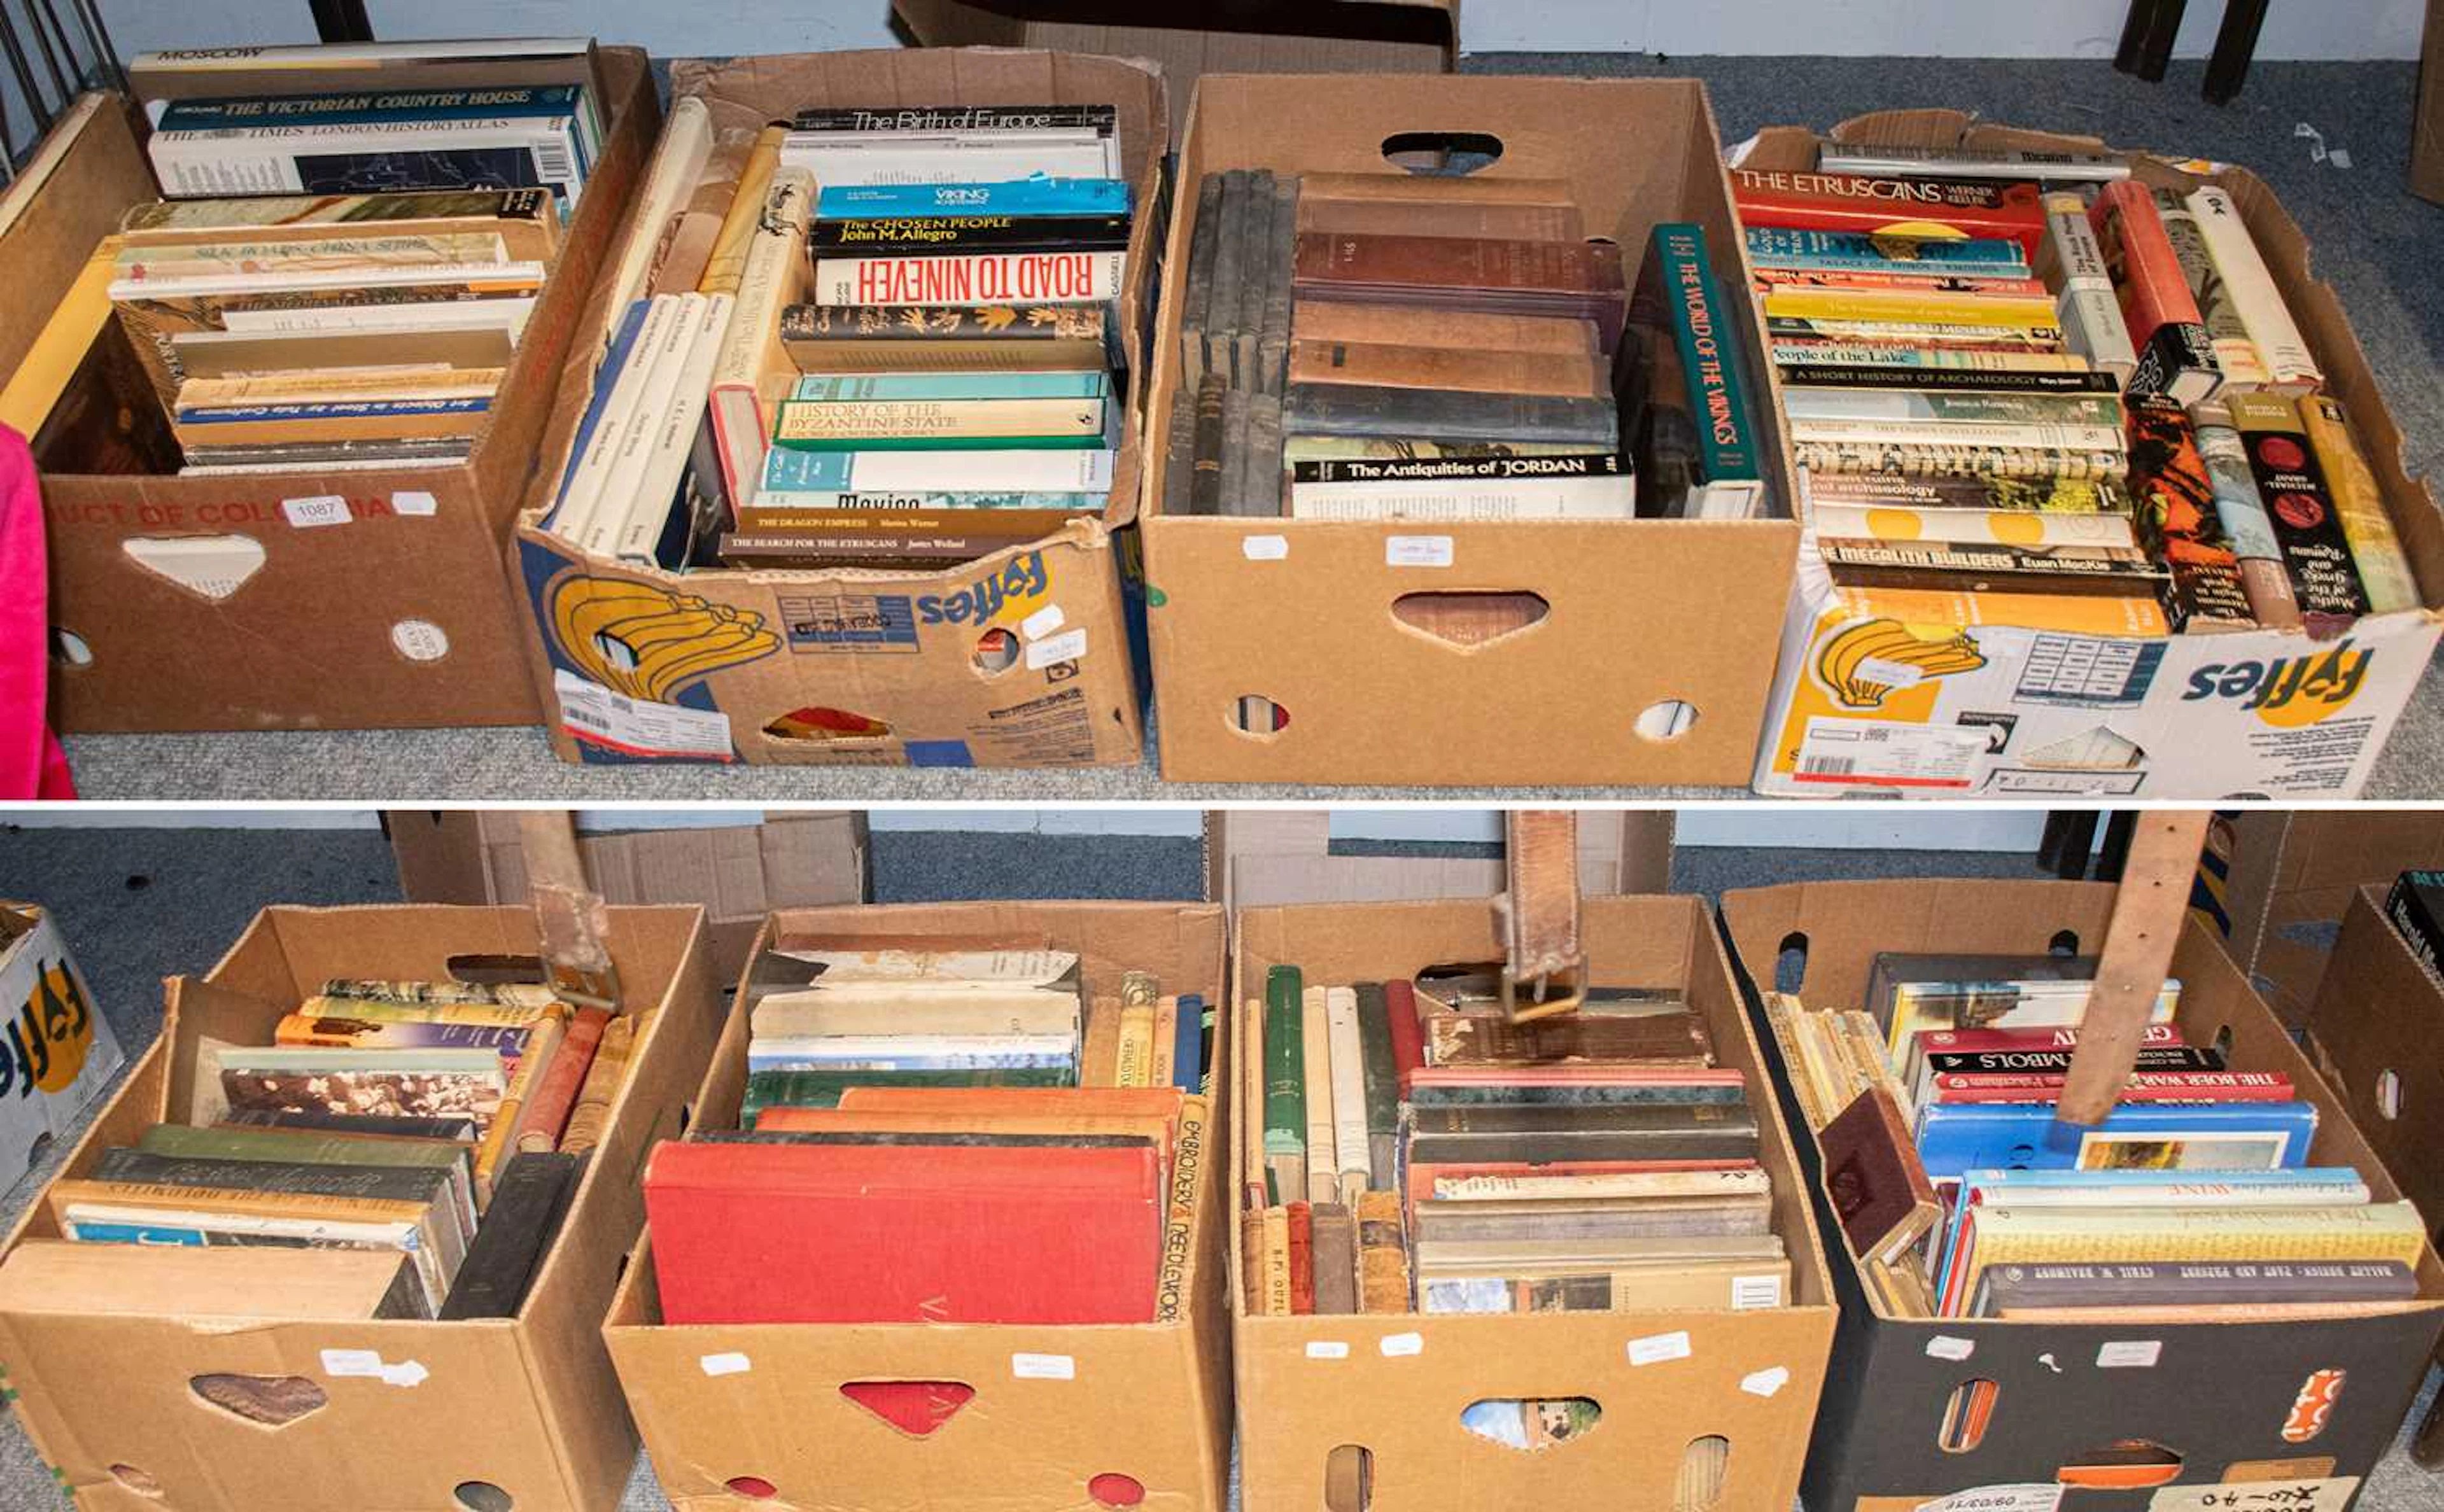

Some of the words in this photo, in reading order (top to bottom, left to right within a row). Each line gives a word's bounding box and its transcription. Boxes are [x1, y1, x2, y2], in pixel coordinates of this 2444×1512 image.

[158, 48, 264, 61] MOSCOW
[225, 103, 263, 116] THE
[267, 97, 370, 115] VICTORIAN
[376, 94, 466, 109] COUNTRY
[468, 90, 532, 106] HOUSE
[853, 111, 893, 130] The
[897, 108, 946, 130] Birth
[949, 106, 971, 129] of
[974, 109, 1051, 128] Europe
[162, 130, 197, 142] THE
[248, 128, 304, 139] TIMES
[1734, 169, 1788, 190] THE
[1792, 174, 1942, 203] ETRUSCANS
[935, 188, 990, 201] VIKING
[841, 220, 870, 230] The
[872, 219, 948, 230] CHOSEN
[950, 217, 1013, 228] PEOPLE
[839, 228, 876, 242] John
[878, 230, 899, 241] M.
[899, 228, 958, 242] Allegro
[977, 256, 1016, 300] TO
[1017, 255, 1094, 298] ROAD
[1678, 262, 1701, 285] THE
[858, 258, 973, 305] NINEVEH
[1683, 284, 1713, 337] WORLD
[1694, 336, 1719, 362] OF
[1822, 349, 1837, 361] of
[1840, 349, 1866, 361] the
[1869, 351, 1909, 363] Lake
[1699, 360, 1724, 384] THE
[1812, 370, 1855, 380] SHORT
[1858, 371, 1914, 381] HISTORY
[791, 404, 870, 417] HISTORY
[904, 404, 943, 417] THE
[1706, 385, 1739, 445] VIKINGS
[789, 417, 899, 430] BYZANTINE
[901, 416, 958, 429] STATE
[1347, 463, 1382, 478] The
[1384, 462, 1475, 479] Antiquities
[1477, 461, 1498, 475] of
[1501, 458, 1587, 476] JORDAN
[1839, 484, 1936, 498] archaeology
[139, 503, 185, 524] OF
[297, 503, 335, 517] 1087
[731, 538, 753, 548] THE
[795, 538, 815, 548] FOR
[817, 538, 838, 549] THE
[1839, 548, 1929, 563] MEGALITH
[1930, 550, 2015, 569] BUILDERS
[2021, 557, 2058, 568] Euan
[2307, 559, 2333, 570] and
[2151, 1072, 2187, 1086] WAR
[2189, 1073, 2239, 1086] BOER
[2241, 1073, 2275, 1086] THE
[1173, 1120, 1202, 1208] EMBROIDERY
[1173, 1207, 1192, 1219] &
[1158, 1222, 1189, 1324] NEEDLEWORK
